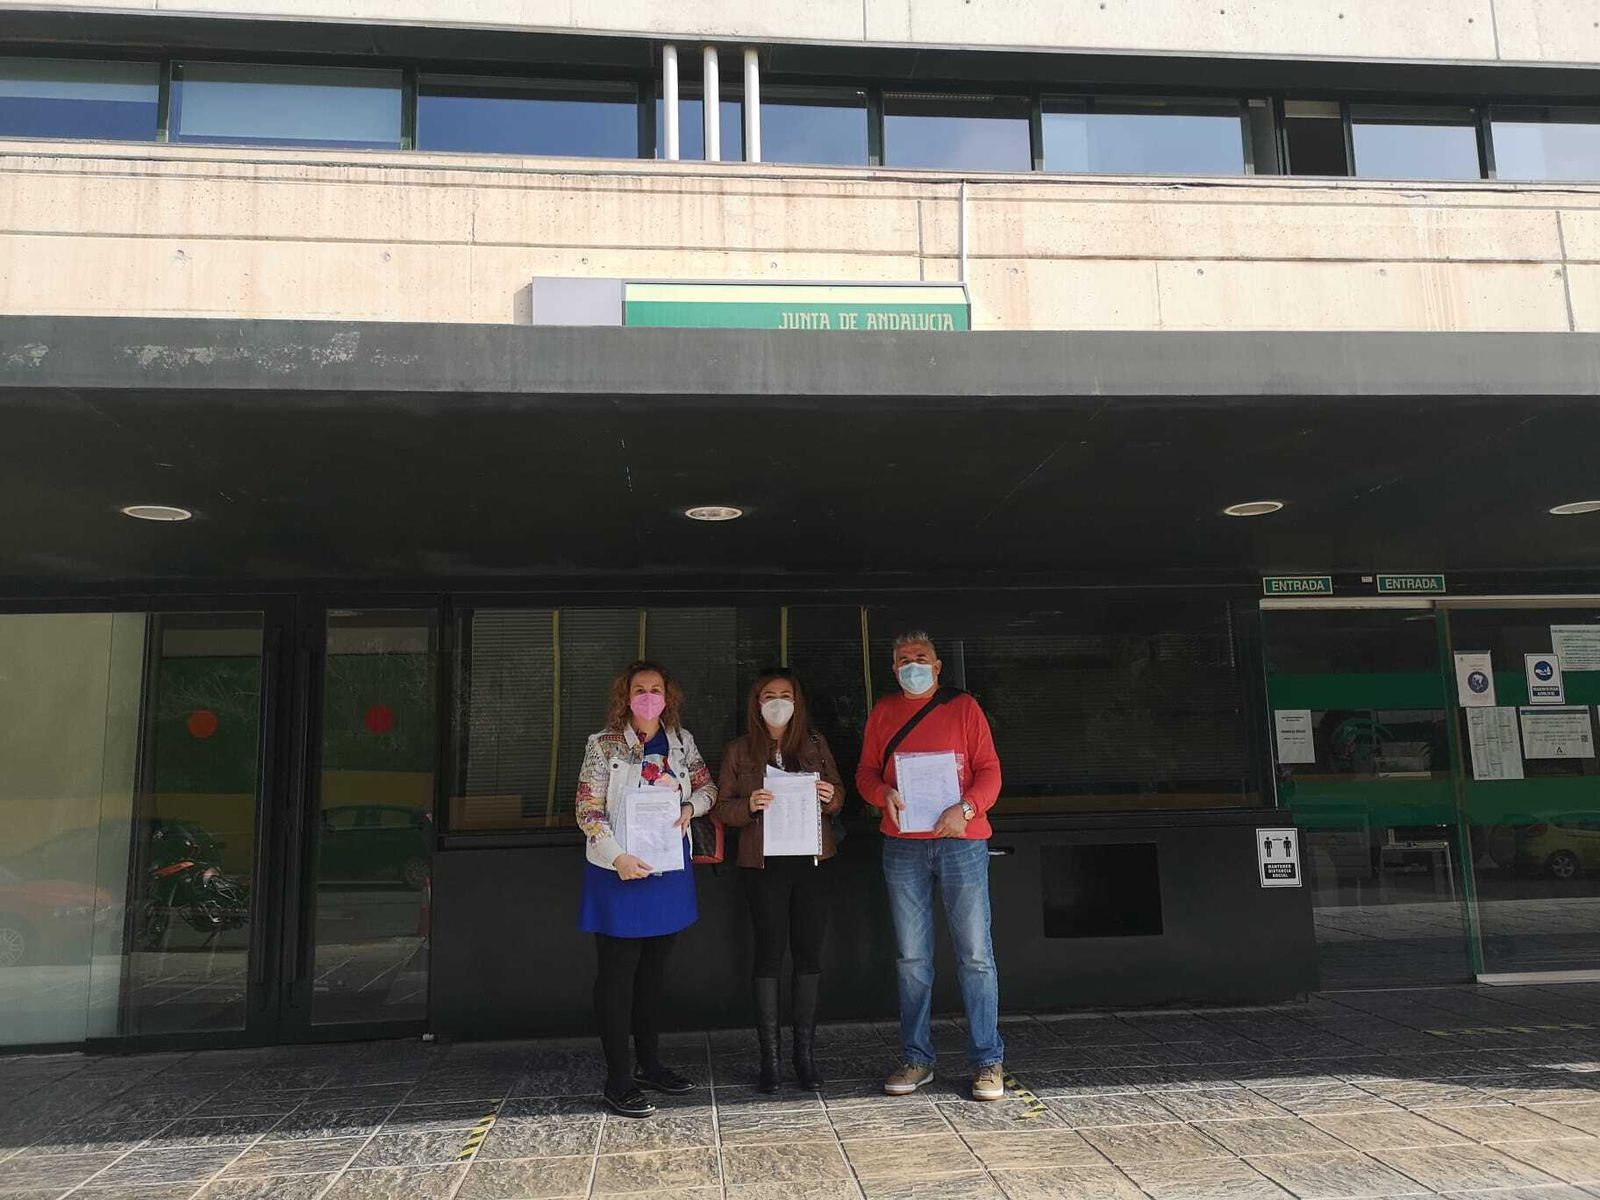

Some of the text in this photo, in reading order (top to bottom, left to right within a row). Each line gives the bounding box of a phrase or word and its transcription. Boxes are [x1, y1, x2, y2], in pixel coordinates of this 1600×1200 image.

[779, 312, 831, 330] JUNTA
[838, 312, 859, 330] DE
[1272, 580, 1325, 592] ENTRADA
[1385, 577, 1438, 590] ENTRADA
